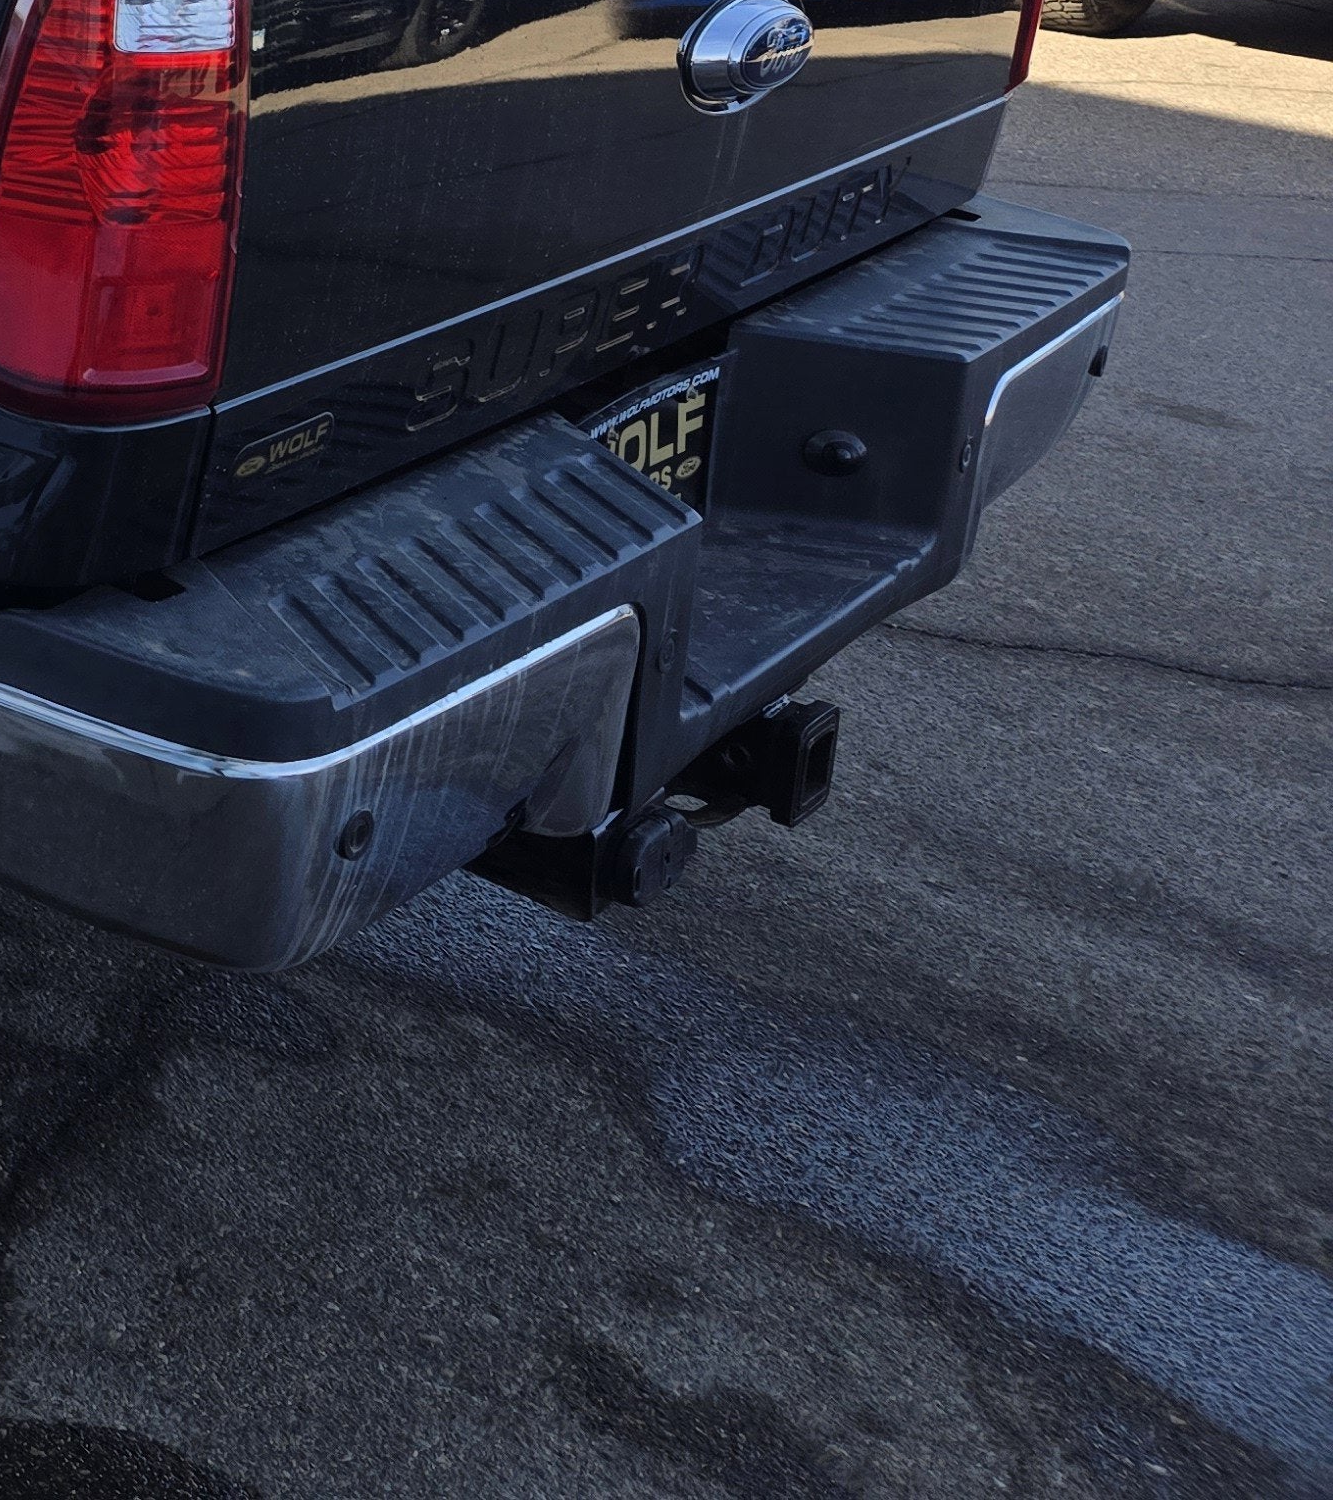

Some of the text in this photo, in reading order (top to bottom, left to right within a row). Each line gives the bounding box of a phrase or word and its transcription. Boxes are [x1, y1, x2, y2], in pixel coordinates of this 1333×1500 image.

[406, 155, 912, 432] SUPER DUTY
[591, 366, 720, 440] WWW.WOLFMOTORSCOM
[269, 420, 331, 463] WOLF
